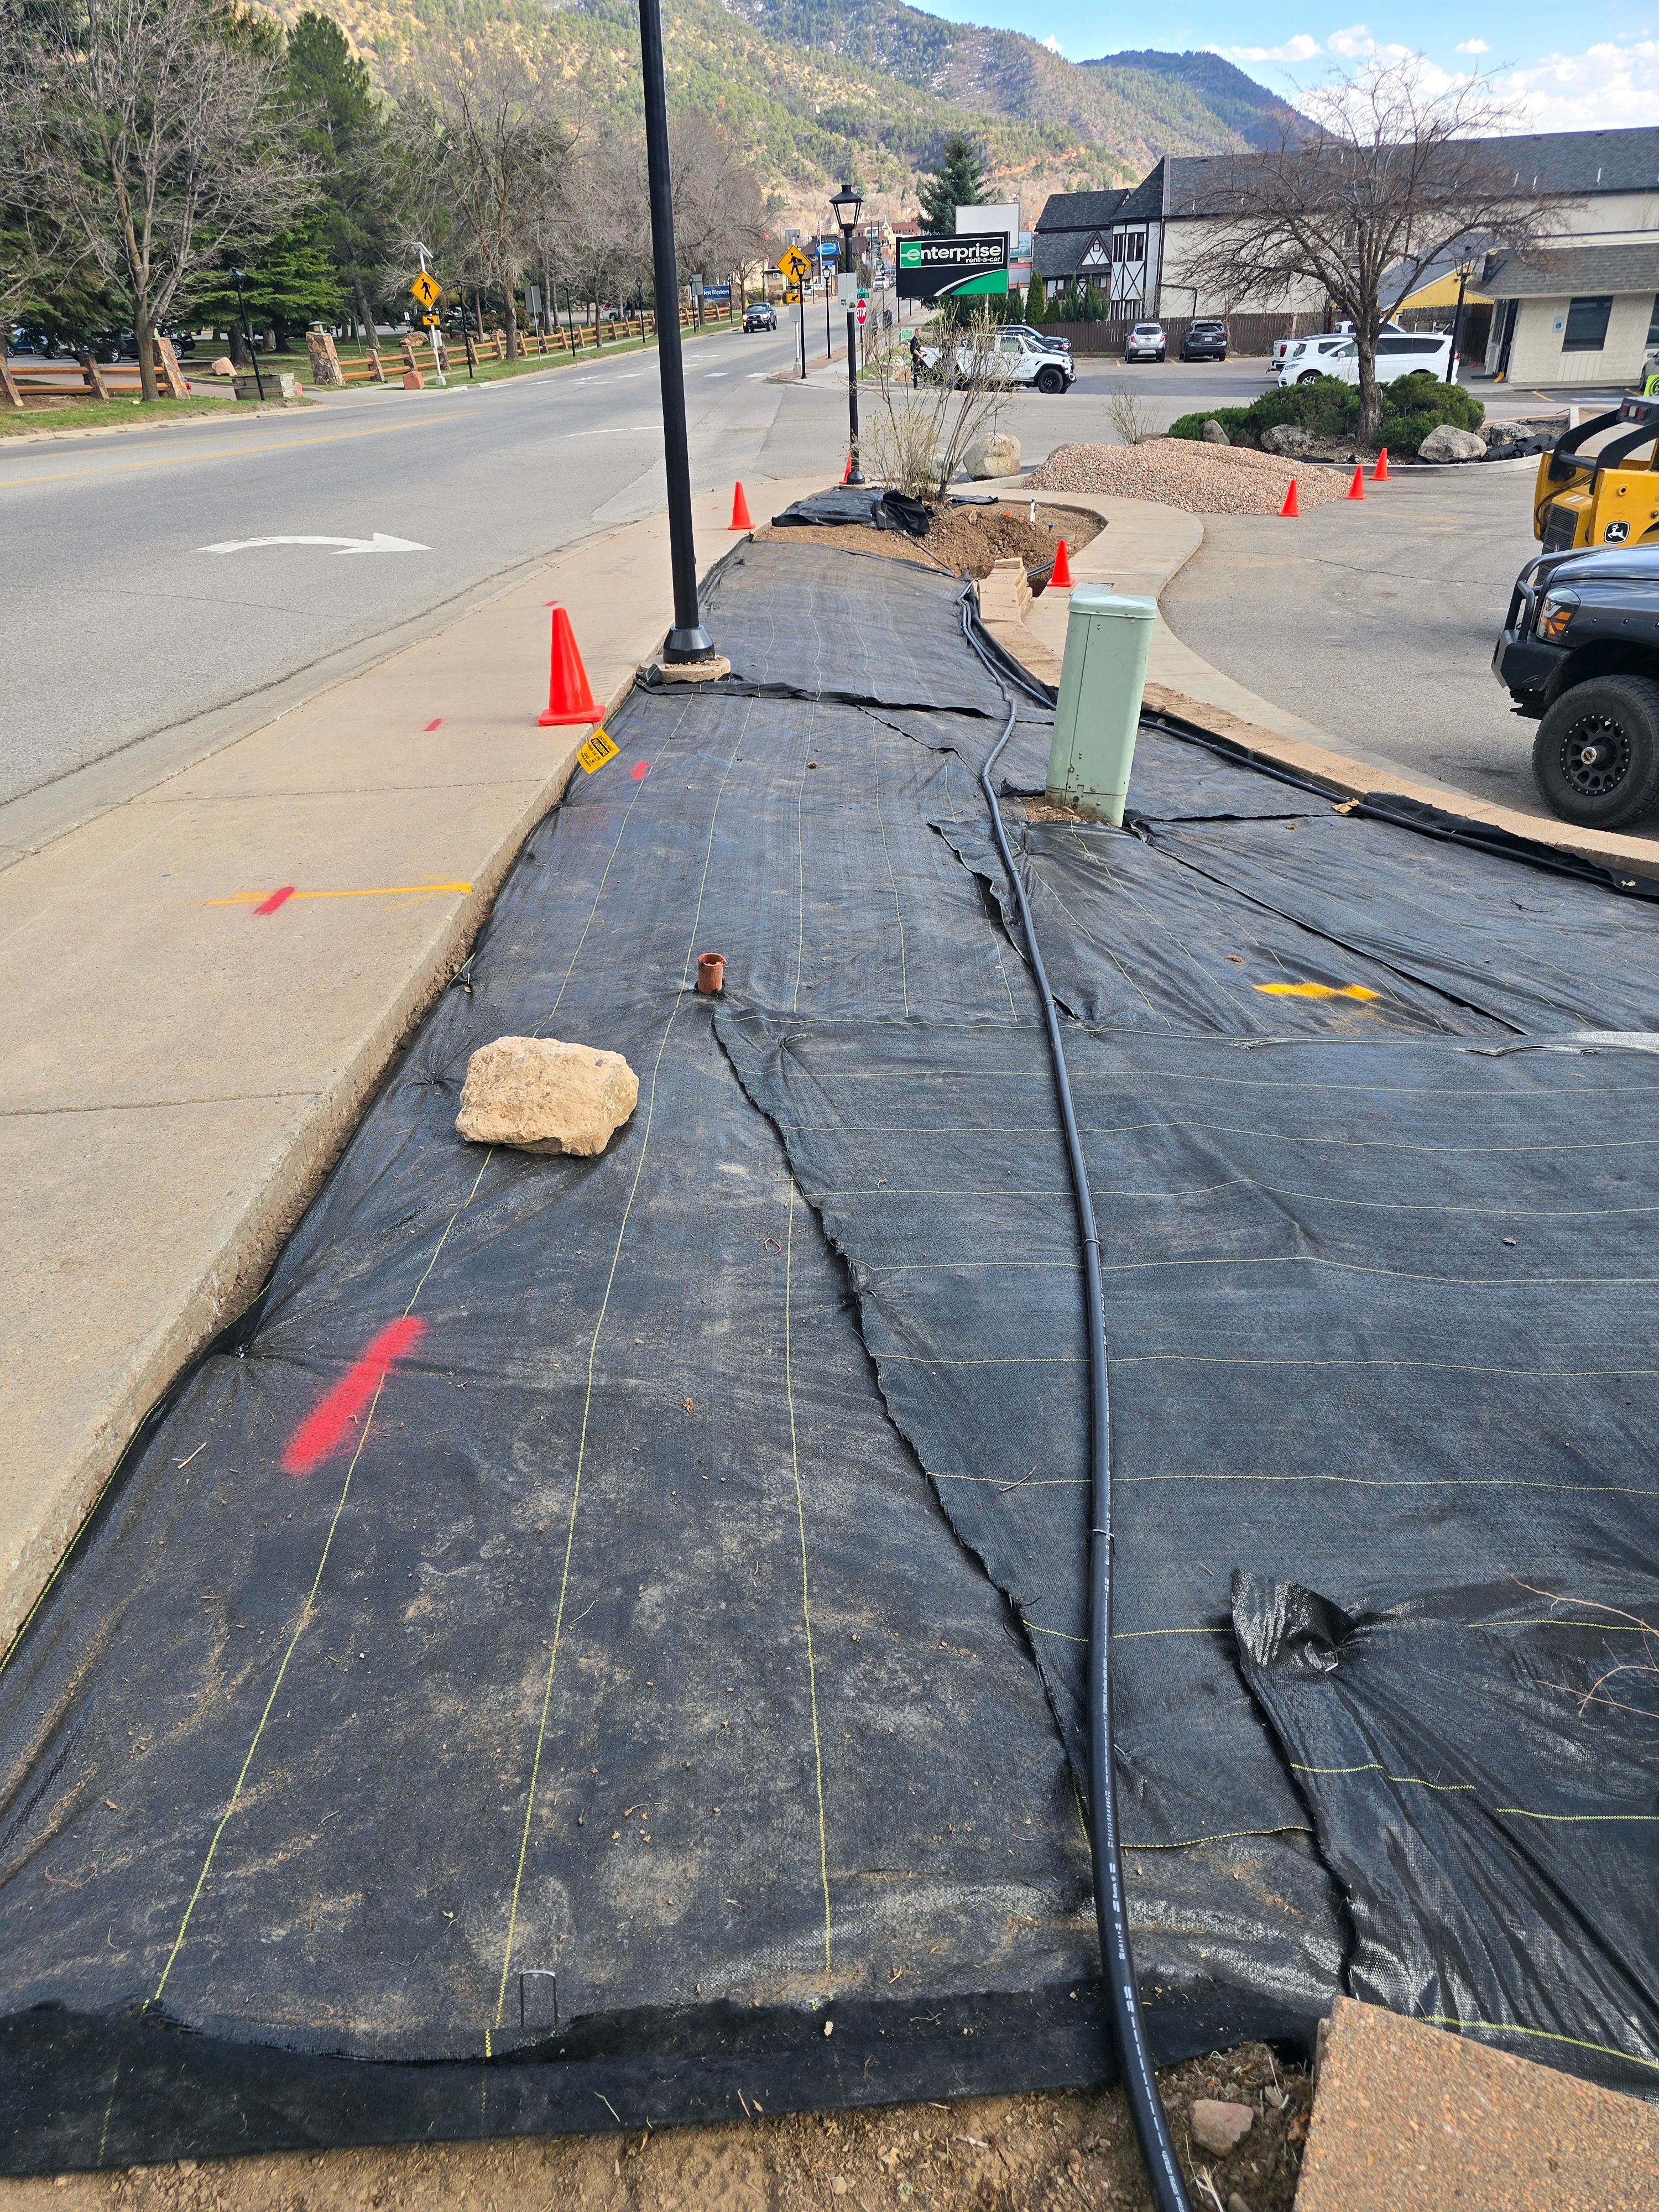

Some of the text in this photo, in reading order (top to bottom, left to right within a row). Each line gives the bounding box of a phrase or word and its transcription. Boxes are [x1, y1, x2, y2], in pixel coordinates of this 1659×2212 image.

[906, 243, 1001, 262] enterprise
[857, 307, 867, 318] STOP
[592, 738, 608, 756] WARNING
